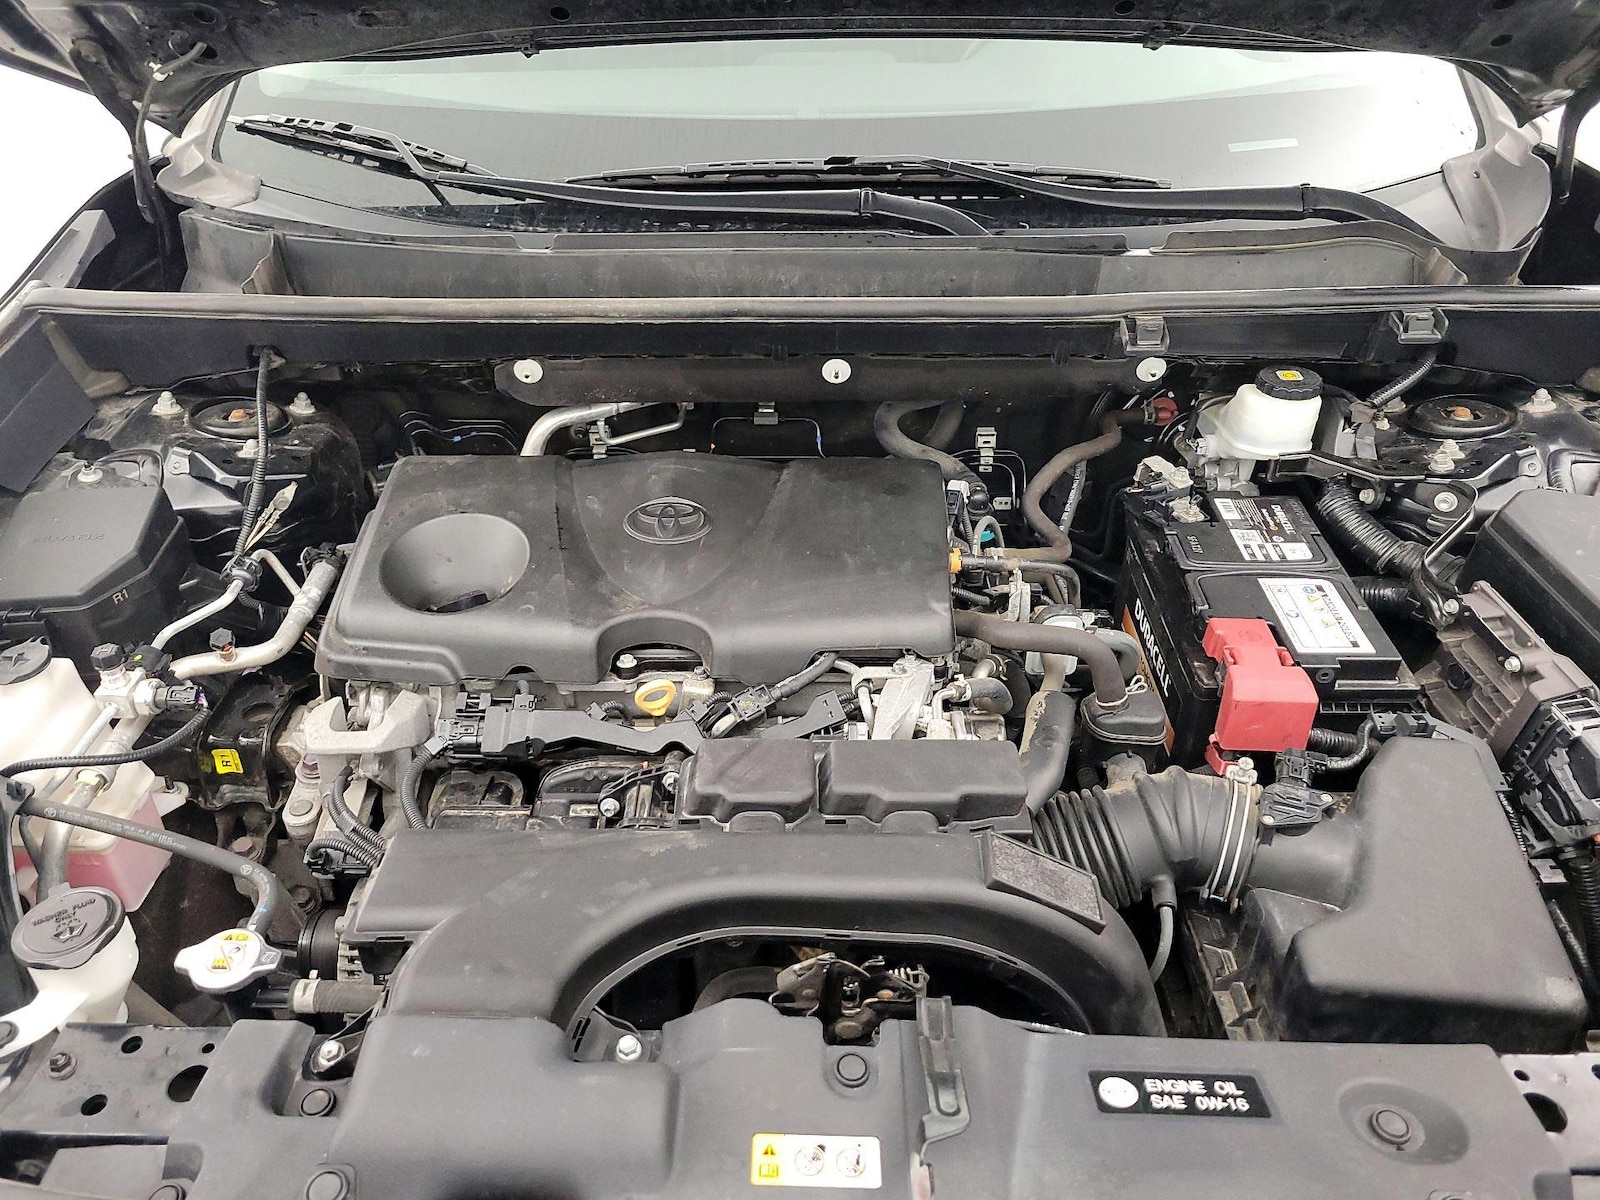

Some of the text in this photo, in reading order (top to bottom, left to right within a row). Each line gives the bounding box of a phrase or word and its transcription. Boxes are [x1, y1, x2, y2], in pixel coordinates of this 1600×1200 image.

[1271, 504, 1297, 535] DURACELL
[112, 588, 129, 605] R1
[1135, 598, 1171, 698] DURACELL
[219, 754, 232, 767] R1
[1144, 1078, 1207, 1095] ENGINE
[1213, 1080, 1245, 1097] OIL
[1150, 1094, 1250, 1113] SAE 0W-16
